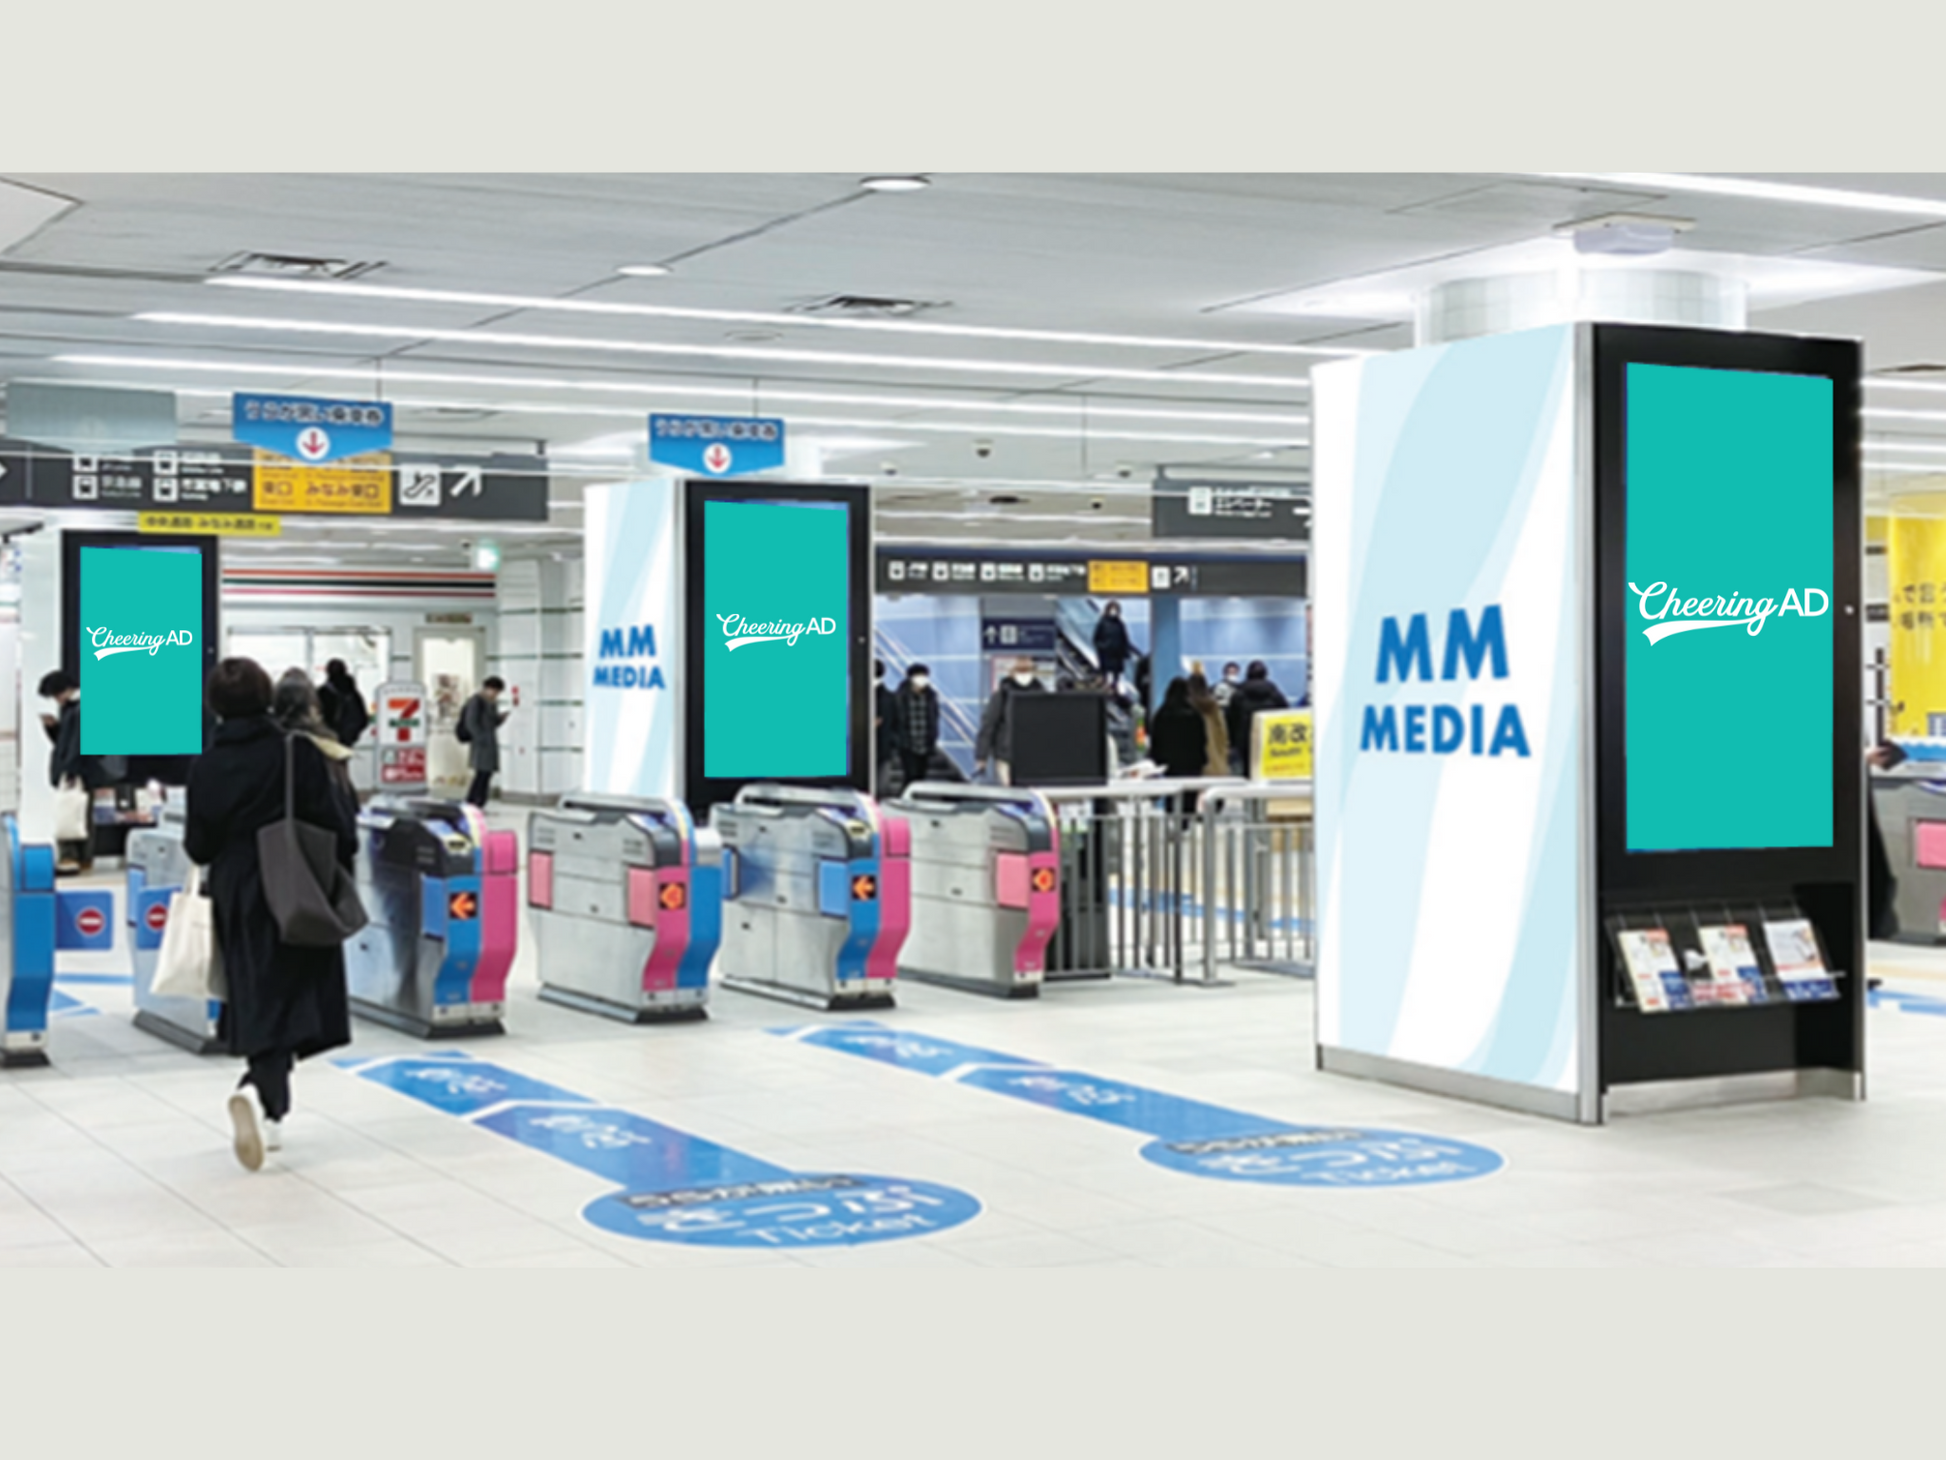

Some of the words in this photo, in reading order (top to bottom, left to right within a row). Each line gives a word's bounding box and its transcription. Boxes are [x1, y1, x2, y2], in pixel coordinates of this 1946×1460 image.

[1628, 581, 1778, 642] Cheering
[1778, 588, 1829, 617] AD
[86, 626, 166, 658] Cheering
[166, 630, 193, 646] AD
[599, 624, 657, 659] MM
[716, 613, 806, 649] Cheering
[806, 617, 836, 635] AD
[1375, 604, 1510, 684] MM
[593, 664, 667, 691] MEDIA
[1360, 703, 1532, 758] MEDIA
[1197, 1137, 1463, 1175] きっぷ
[1302, 1160, 1477, 1184] Ticket
[637, 1184, 945, 1233] きっぷ
[735, 1213, 939, 1244] Ticket
